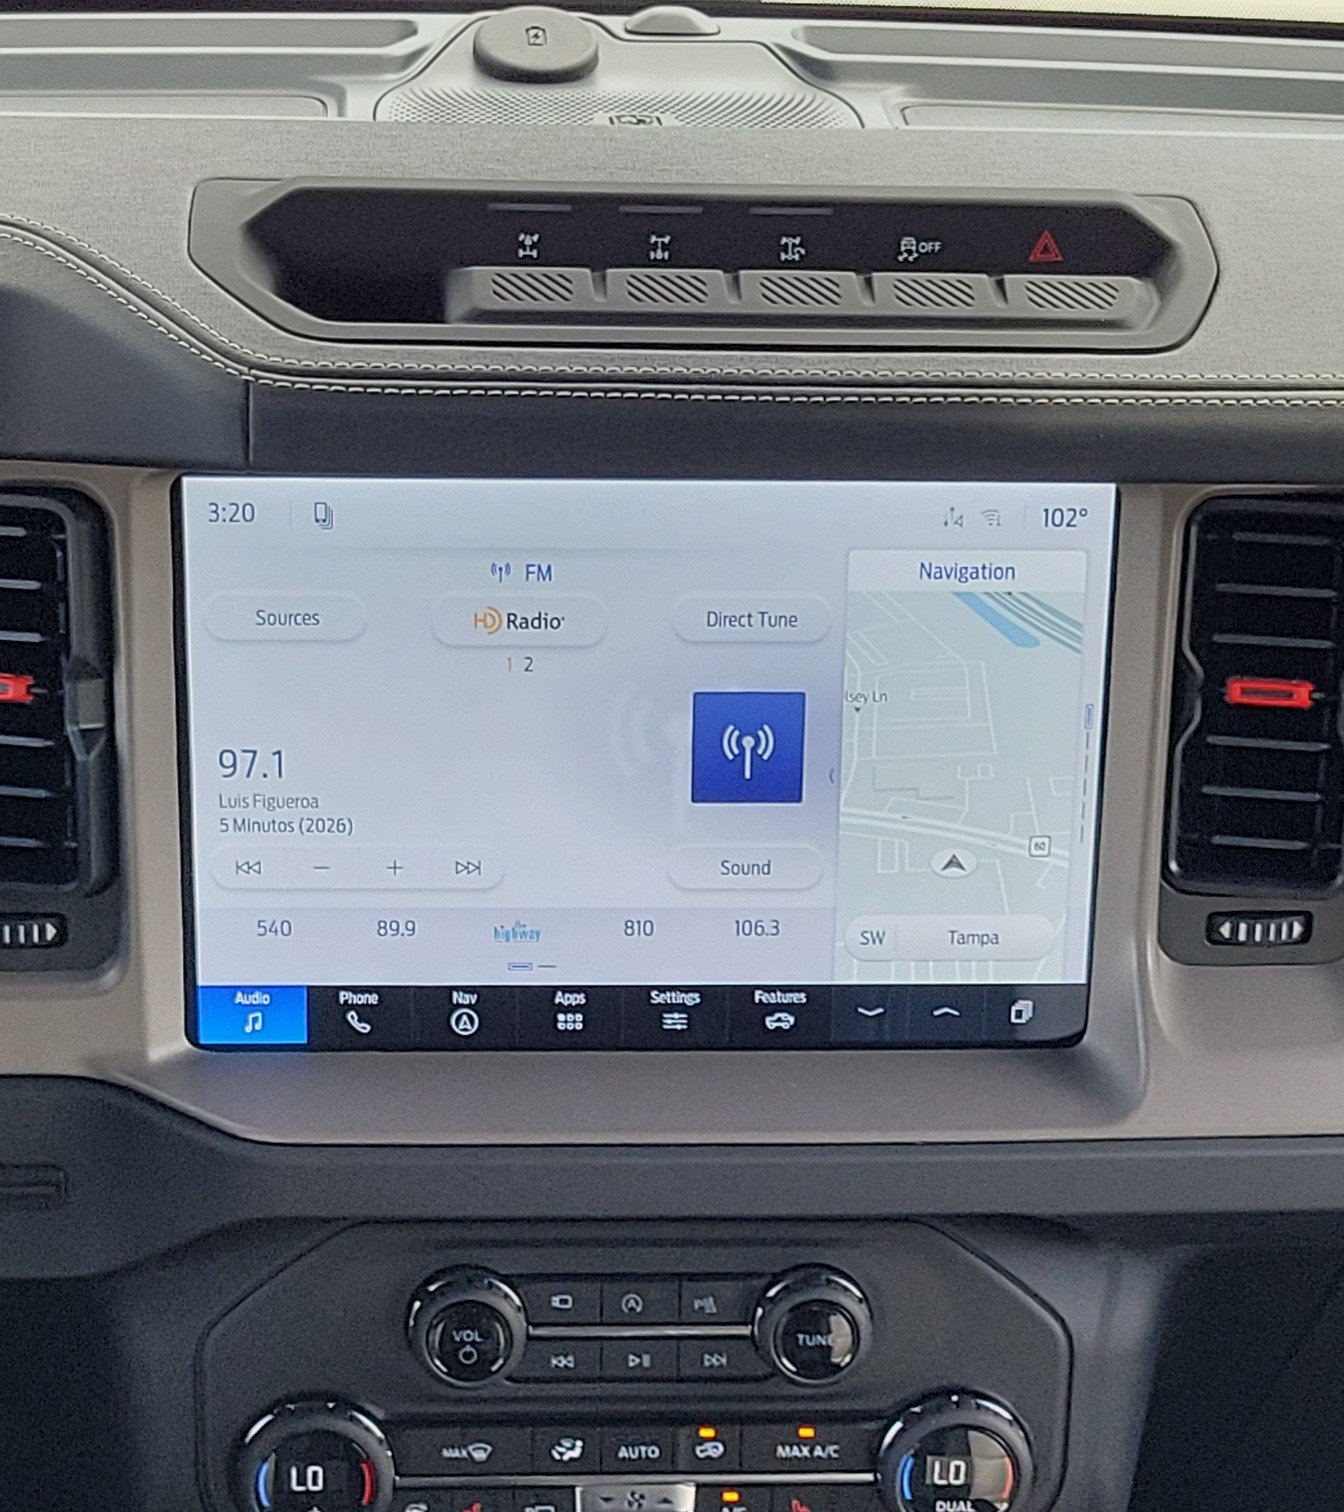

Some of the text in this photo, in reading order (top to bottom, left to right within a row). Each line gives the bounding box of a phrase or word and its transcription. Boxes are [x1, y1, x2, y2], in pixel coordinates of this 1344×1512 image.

[918, 241, 942, 253] OFF
[207, 501, 255, 523] 3:20
[1043, 507, 1088, 528] 102°
[525, 563, 553, 582] FM
[918, 561, 1016, 583] Navigation
[255, 608, 321, 627] Sources
[706, 610, 799, 629] Direct Tune
[523, 656, 534, 673] 2
[872, 690, 888, 703] Ln
[218, 749, 285, 779] 97.1
[218, 793, 320, 812] Luis Figueroa
[219, 817, 354, 836] 5 Minutos (2026)
[720, 859, 771, 877] Sound
[256, 919, 293, 937] 540
[376, 919, 416, 938] 89.9
[623, 919, 654, 938] 810
[733, 919, 781, 938] 106.3
[859, 930, 886, 946] SW
[948, 930, 1000, 947] Tampa
[234, 990, 271, 1006] Audio
[339, 990, 379, 1006] Phone
[452, 990, 478, 1006] Nav
[555, 990, 586, 1007] Apps
[649, 989, 701, 1007] Settings
[754, 989, 807, 1005] Features
[453, 1329, 484, 1343] VOL
[618, 1445, 660, 1460] AUTO
[776, 1444, 840, 1459] MAX A/C
[289, 1465, 324, 1492] LO
[933, 1460, 967, 1486] LO
